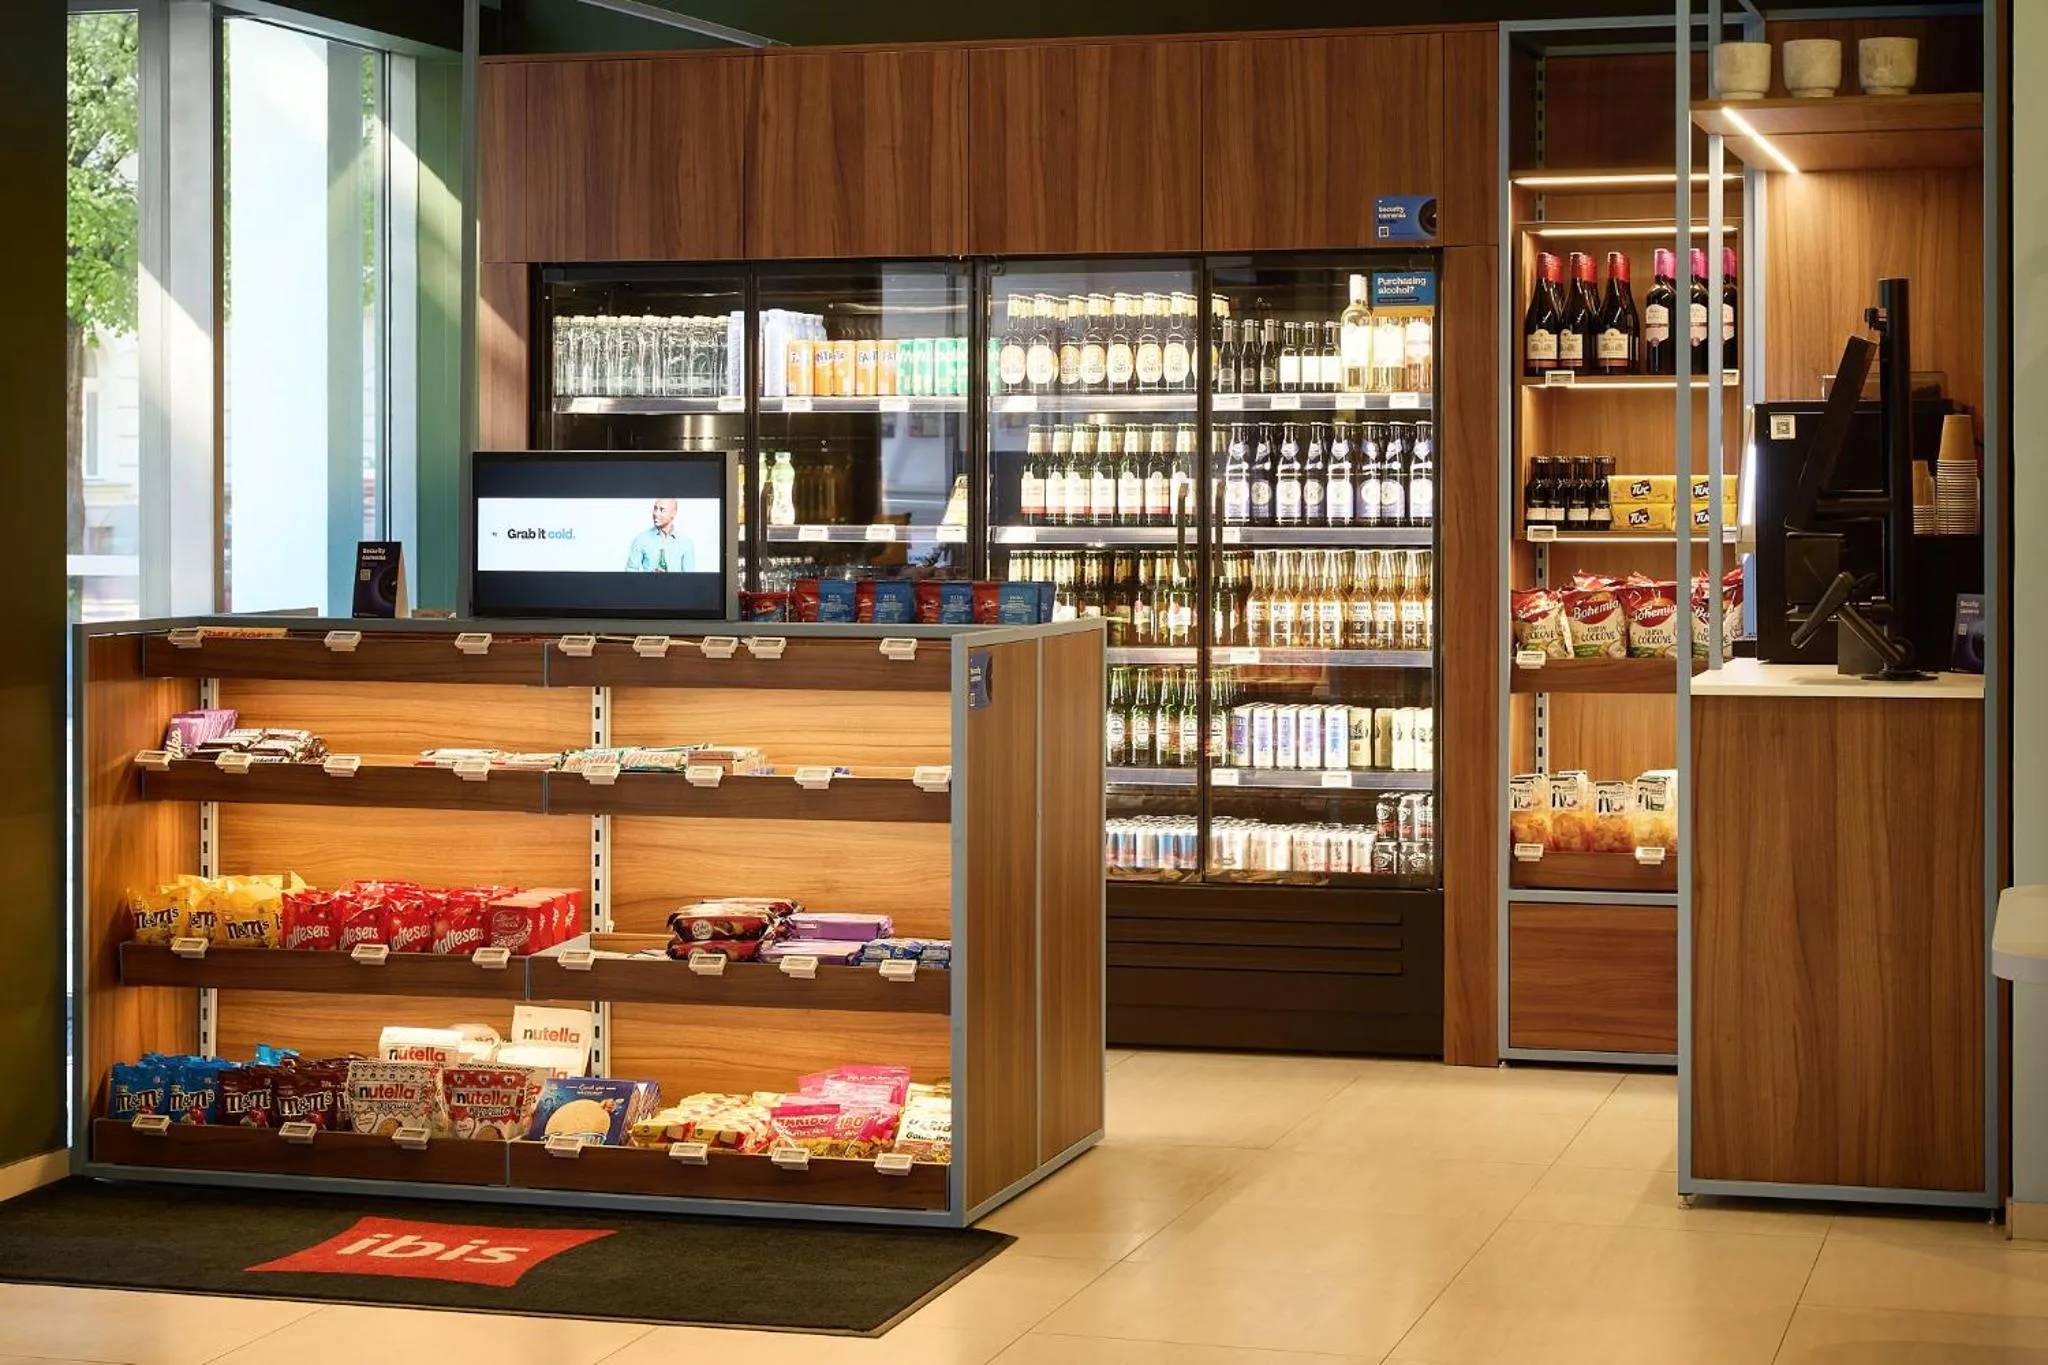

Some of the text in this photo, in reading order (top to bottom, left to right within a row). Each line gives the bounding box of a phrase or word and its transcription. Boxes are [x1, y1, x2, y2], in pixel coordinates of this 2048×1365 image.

[1378, 206, 1405, 214] Security
[1377, 277, 1427, 286] Purchasing
[1377, 286, 1415, 294] alcohol?
[507, 527, 575, 540] Grab it cold.
[1573, 600, 1620, 621] Bohemia
[286, 924, 330, 949] altesers
[339, 926, 379, 950] altesers
[523, 1026, 580, 1043] nutella
[388, 1046, 446, 1062] nutella
[358, 1083, 416, 1101] nutella
[456, 1088, 512, 1106] nutella
[336, 1233, 531, 1264] ibis
